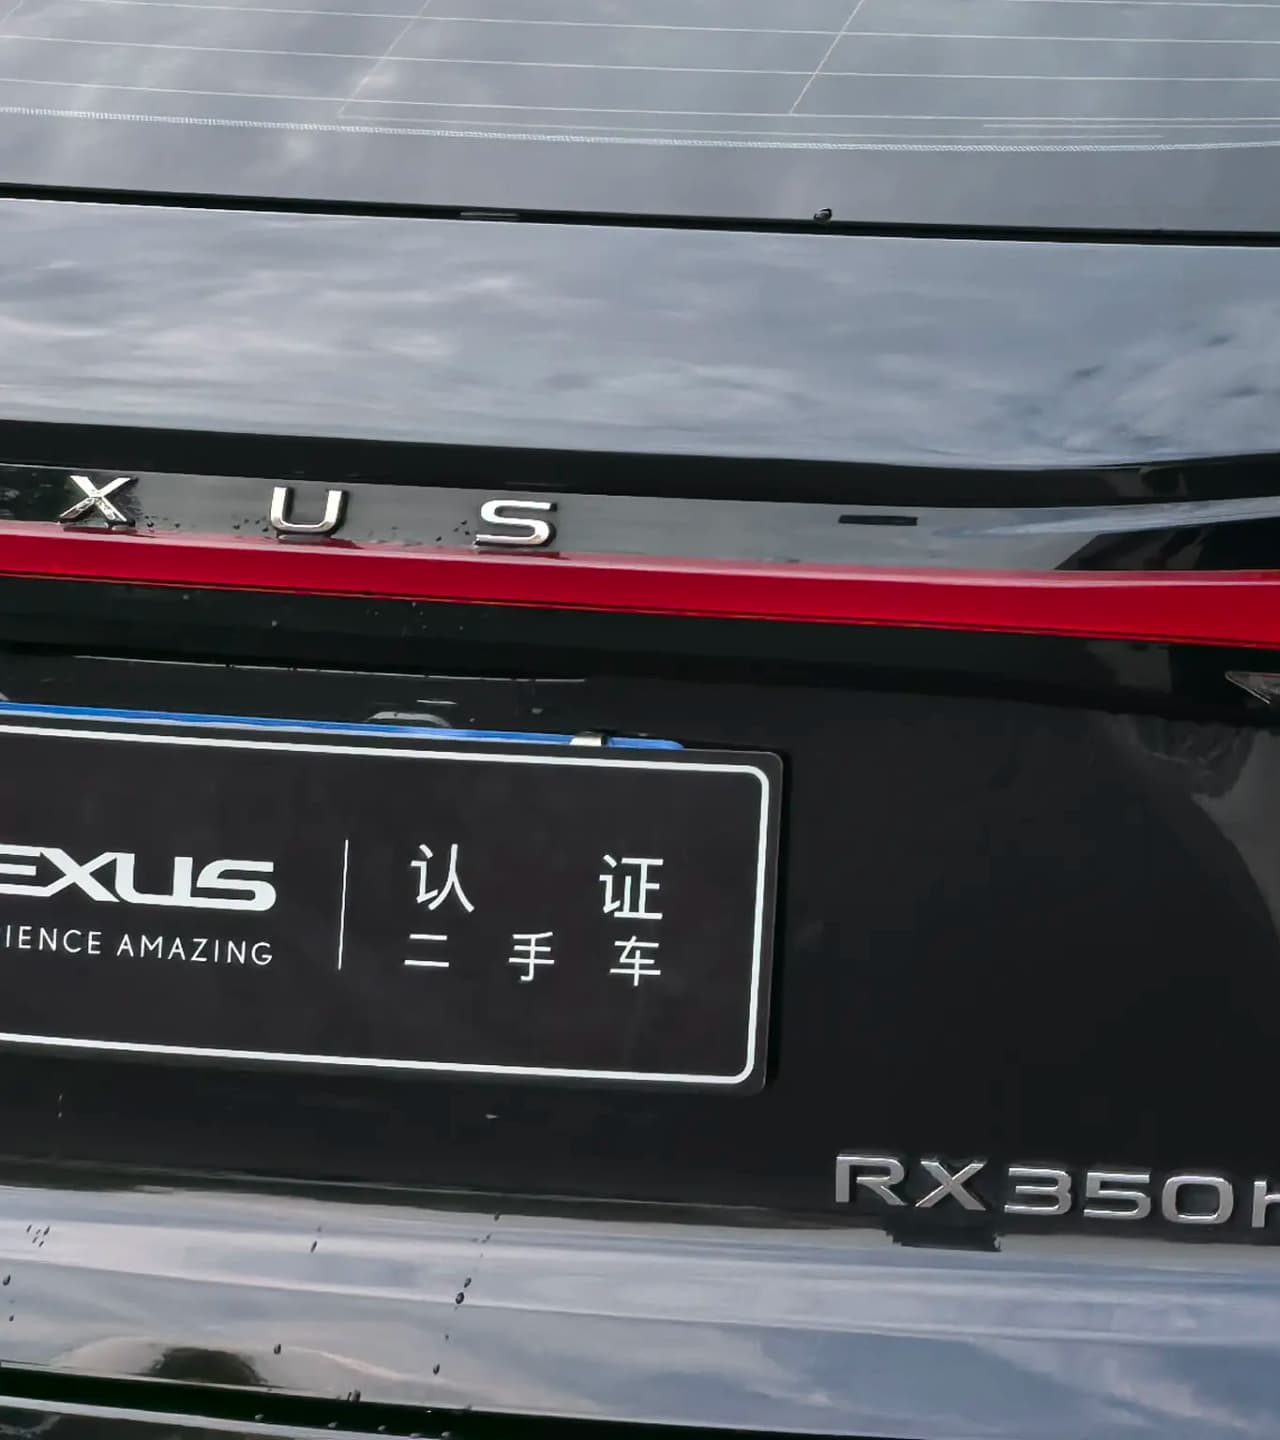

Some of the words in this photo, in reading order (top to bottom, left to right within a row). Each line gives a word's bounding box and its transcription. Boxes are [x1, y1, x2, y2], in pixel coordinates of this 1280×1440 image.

[58, 474, 558, 547] XUS
[410, 843, 664, 920] 认证
[5, 924, 102, 955] IENCE
[116, 933, 273, 966] AMAZING
[404, 931, 661, 986] 二手车
